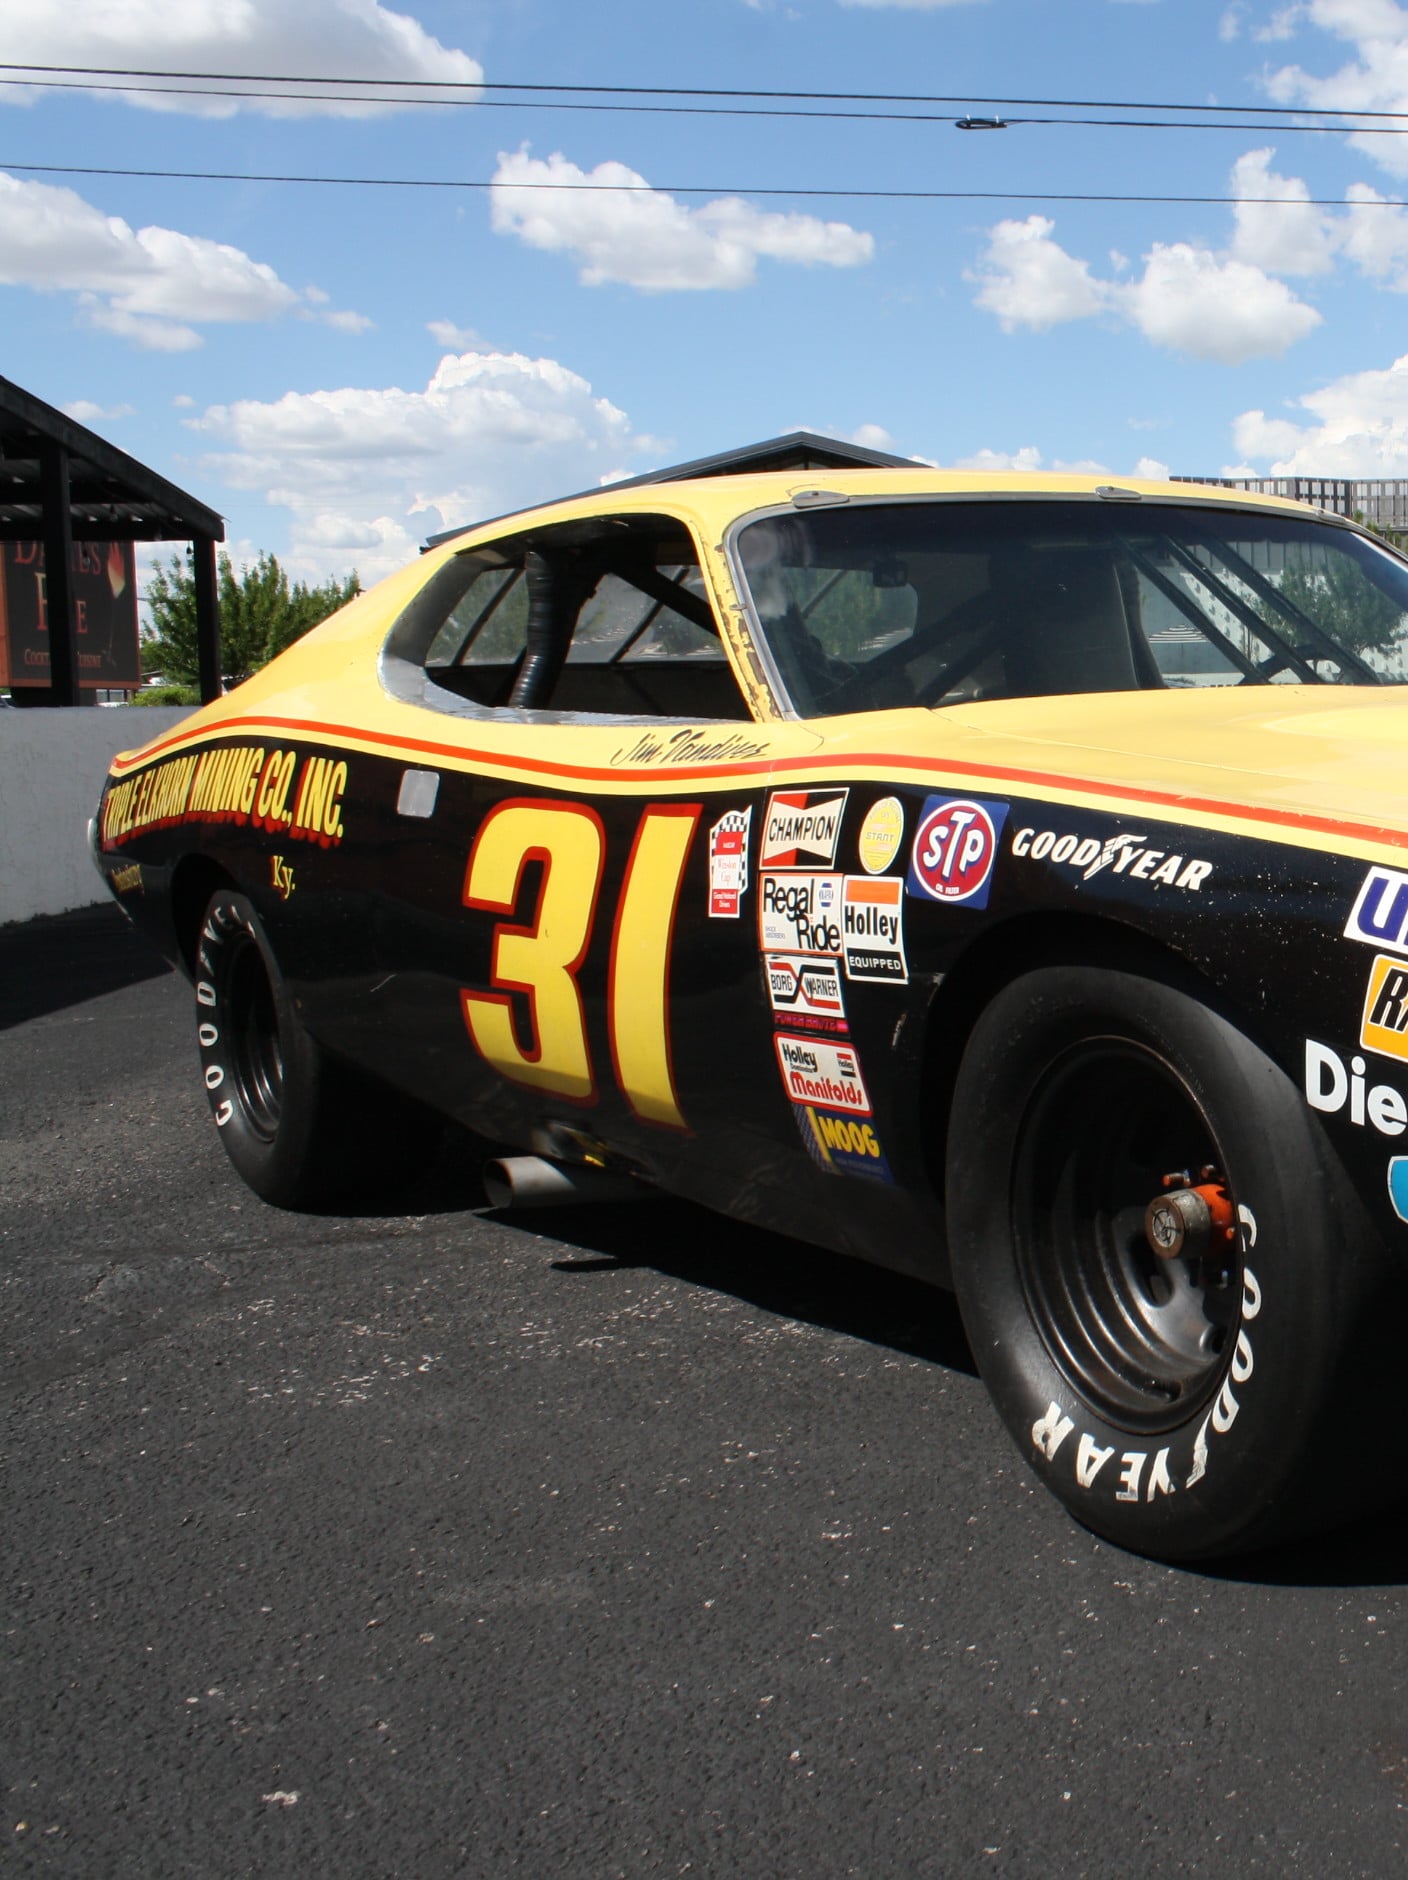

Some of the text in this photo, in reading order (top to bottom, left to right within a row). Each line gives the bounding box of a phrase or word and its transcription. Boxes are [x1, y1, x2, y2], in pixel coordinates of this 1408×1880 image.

[610, 733, 664, 766] Jim
[103, 774, 143, 843] TRIPLE
[135, 754, 199, 828] ELKHORN
[188, 747, 265, 815] MINING
[296, 757, 348, 838] INC.
[768, 815, 836, 842] CHAMPION
[865, 831, 895, 842] STANT
[922, 811, 985, 880] STP
[272, 855, 296, 900] Ky.
[1011, 828, 1213, 891] GOODYEAR
[763, 877, 815, 923] Regal
[796, 914, 841, 952] Ride
[845, 905, 899, 945] Holley
[460, 799, 702, 1135] 31
[848, 956, 901, 970] EQUIPPED
[770, 974, 839, 997] BORG WARNER
[782, 1043, 818, 1073] Holley
[789, 1071, 863, 1105] Manifolds
[817, 1115, 881, 1158] MOOG
